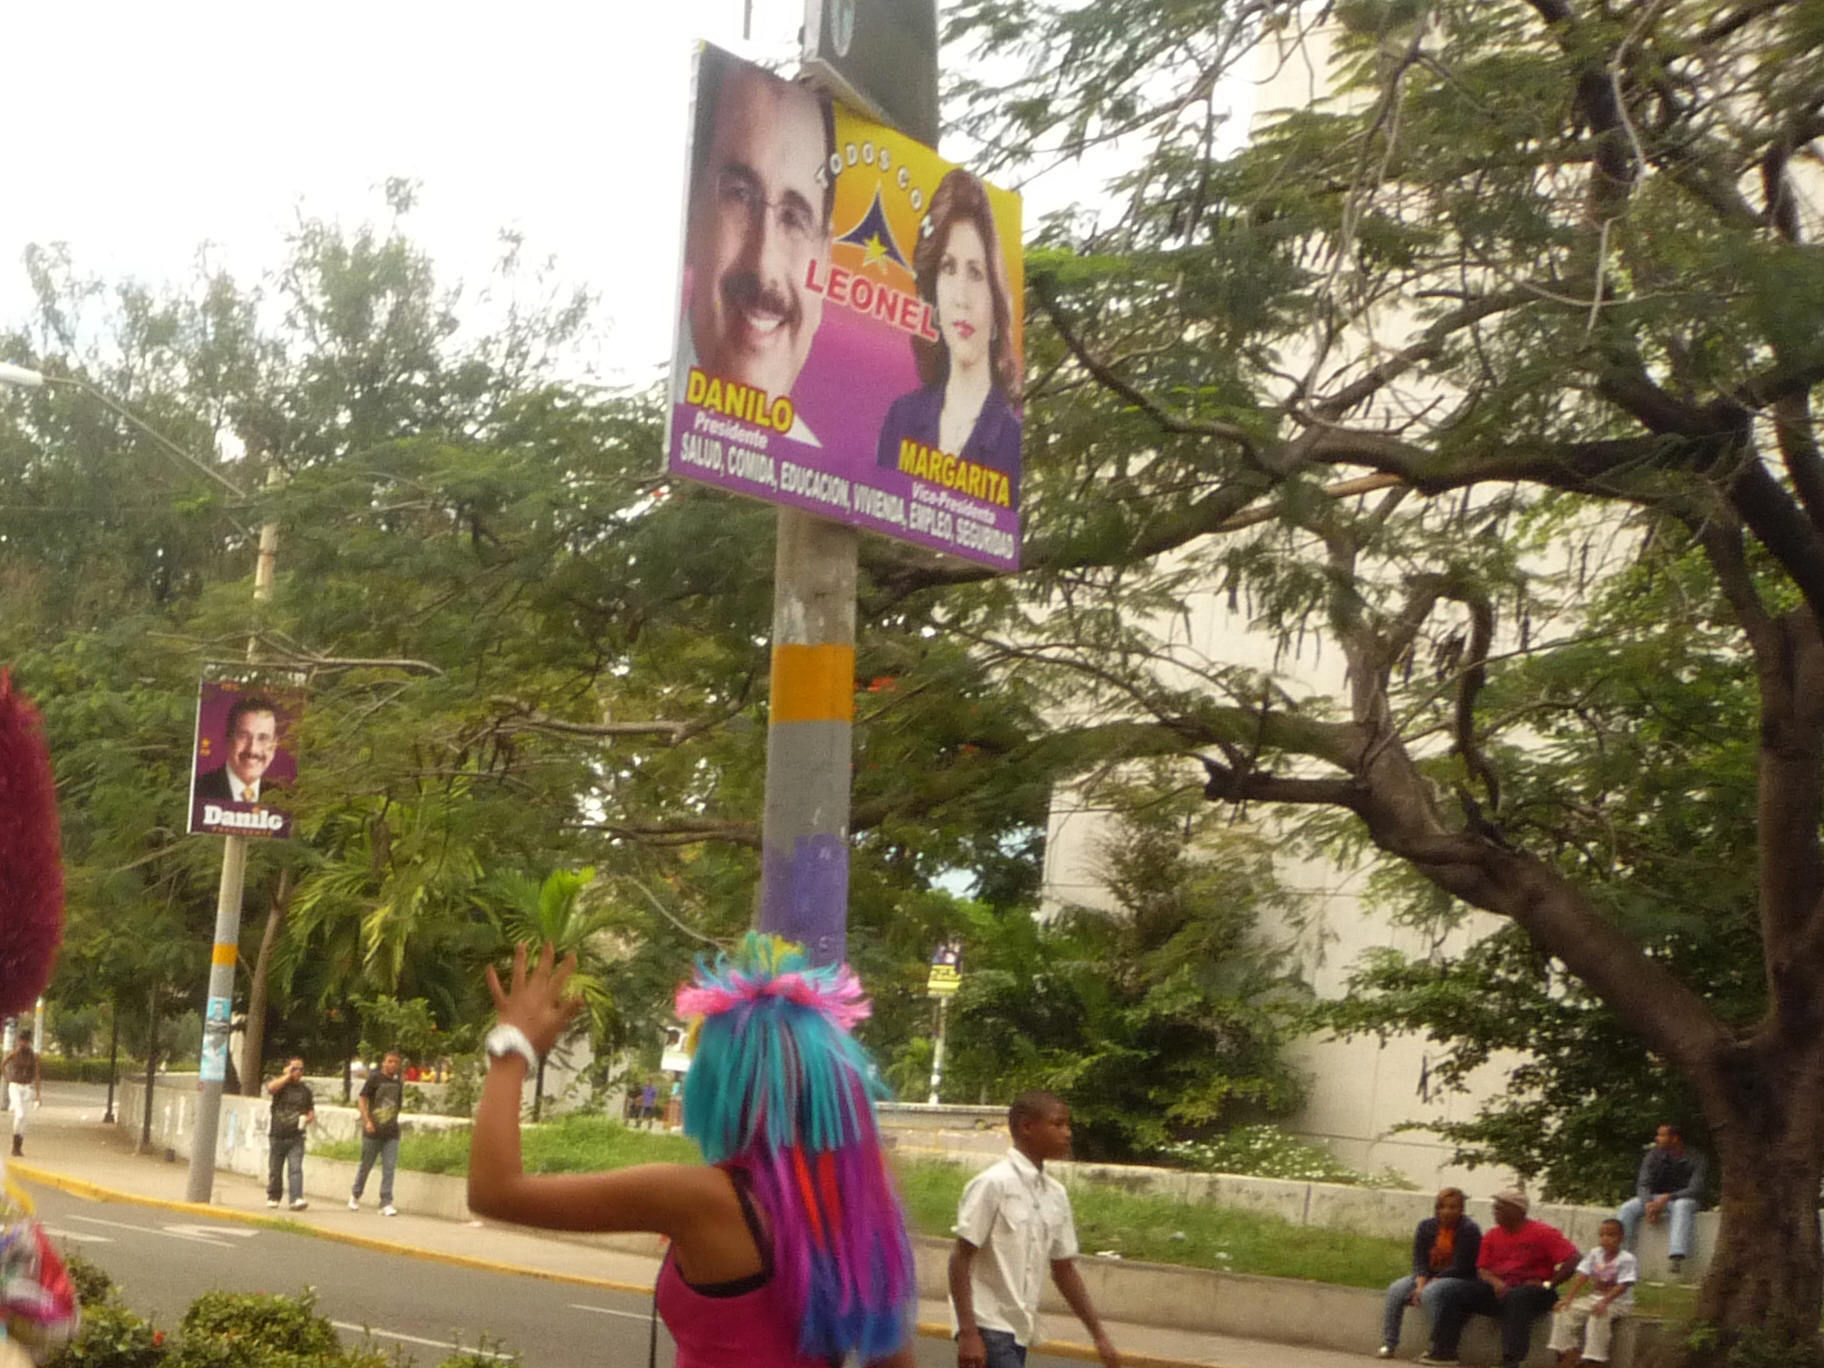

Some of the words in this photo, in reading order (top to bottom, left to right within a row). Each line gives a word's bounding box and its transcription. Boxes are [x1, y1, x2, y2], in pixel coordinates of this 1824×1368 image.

[815, 141, 892, 190] TODOS
[896, 163, 936, 239] CON
[803, 257, 940, 342] LEONEL
[686, 368, 795, 433] DANILO
[694, 410, 769, 450] Presidente
[680, 431, 725, 477] SALUD,
[727, 444, 778, 493] COMIDA,
[898, 438, 1011, 508] MARGARITA
[202, 804, 283, 831] Danilo
